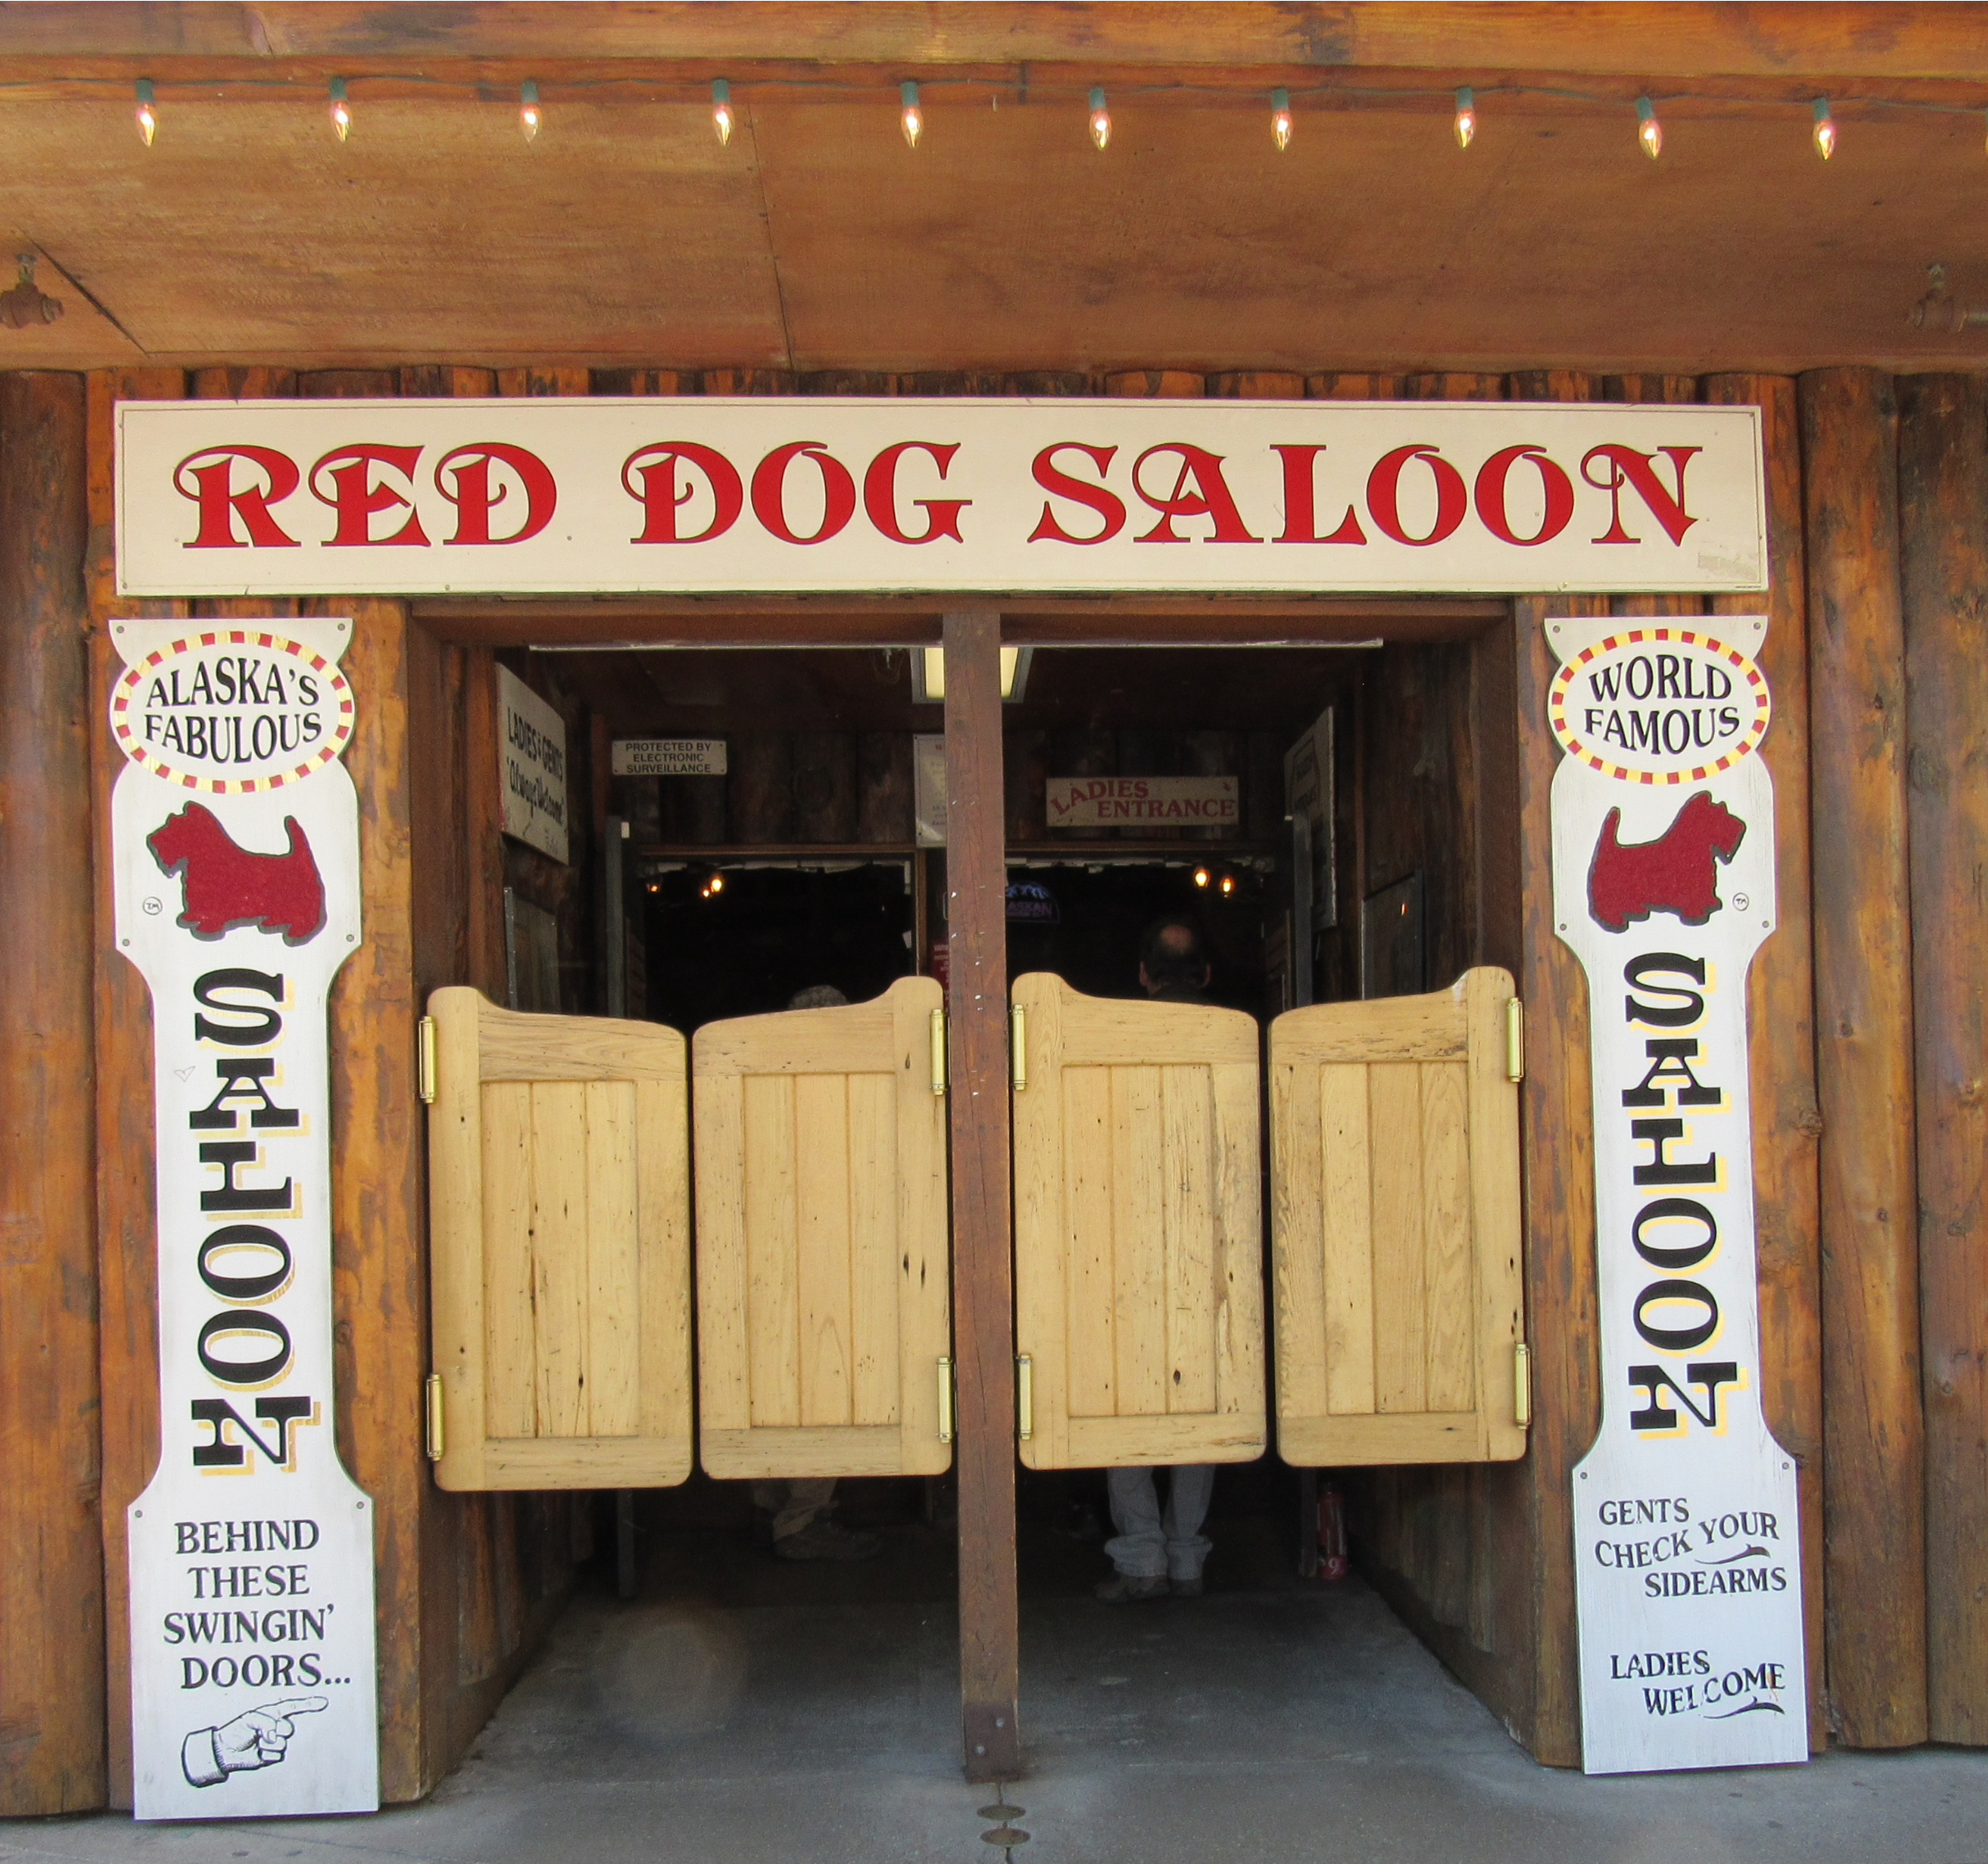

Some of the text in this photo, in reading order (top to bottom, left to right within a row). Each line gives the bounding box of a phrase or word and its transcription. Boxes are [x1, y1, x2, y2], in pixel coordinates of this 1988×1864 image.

[173, 440, 1703, 548] RED DOG SALOON
[146, 656, 321, 708] ALASKA'S
[1588, 654, 1732, 703] WORLD
[145, 712, 322, 764] FABULOUS
[507, 706, 538, 762] LADIES
[626, 742, 711, 752] PROTECTED BY
[1583, 706, 1740, 755] FAMOUS
[626, 764, 711, 773] SURVEILLANCE
[633, 752, 705, 762] ELECTRONIC
[1050, 779, 1149, 815] LADIES
[1097, 799, 1236, 819] ENTRANCE
[1622, 951, 1747, 1438] SALOON
[189, 968, 320, 1475] SALOON
[1599, 1498, 1690, 1526] GENTS
[174, 1520, 320, 1554] BEHIND
[1595, 1511, 1779, 1568] CHECK YOUR
[186, 1565, 310, 1599] THESE
[1644, 1566, 1787, 1597] SIDEARMS
[164, 1603, 334, 1645] SWINGIN'
[181, 1653, 351, 1689] DOORS...
[1610, 1650, 1711, 1680] LADIES
[1642, 1662, 1785, 1715] WELCOME
